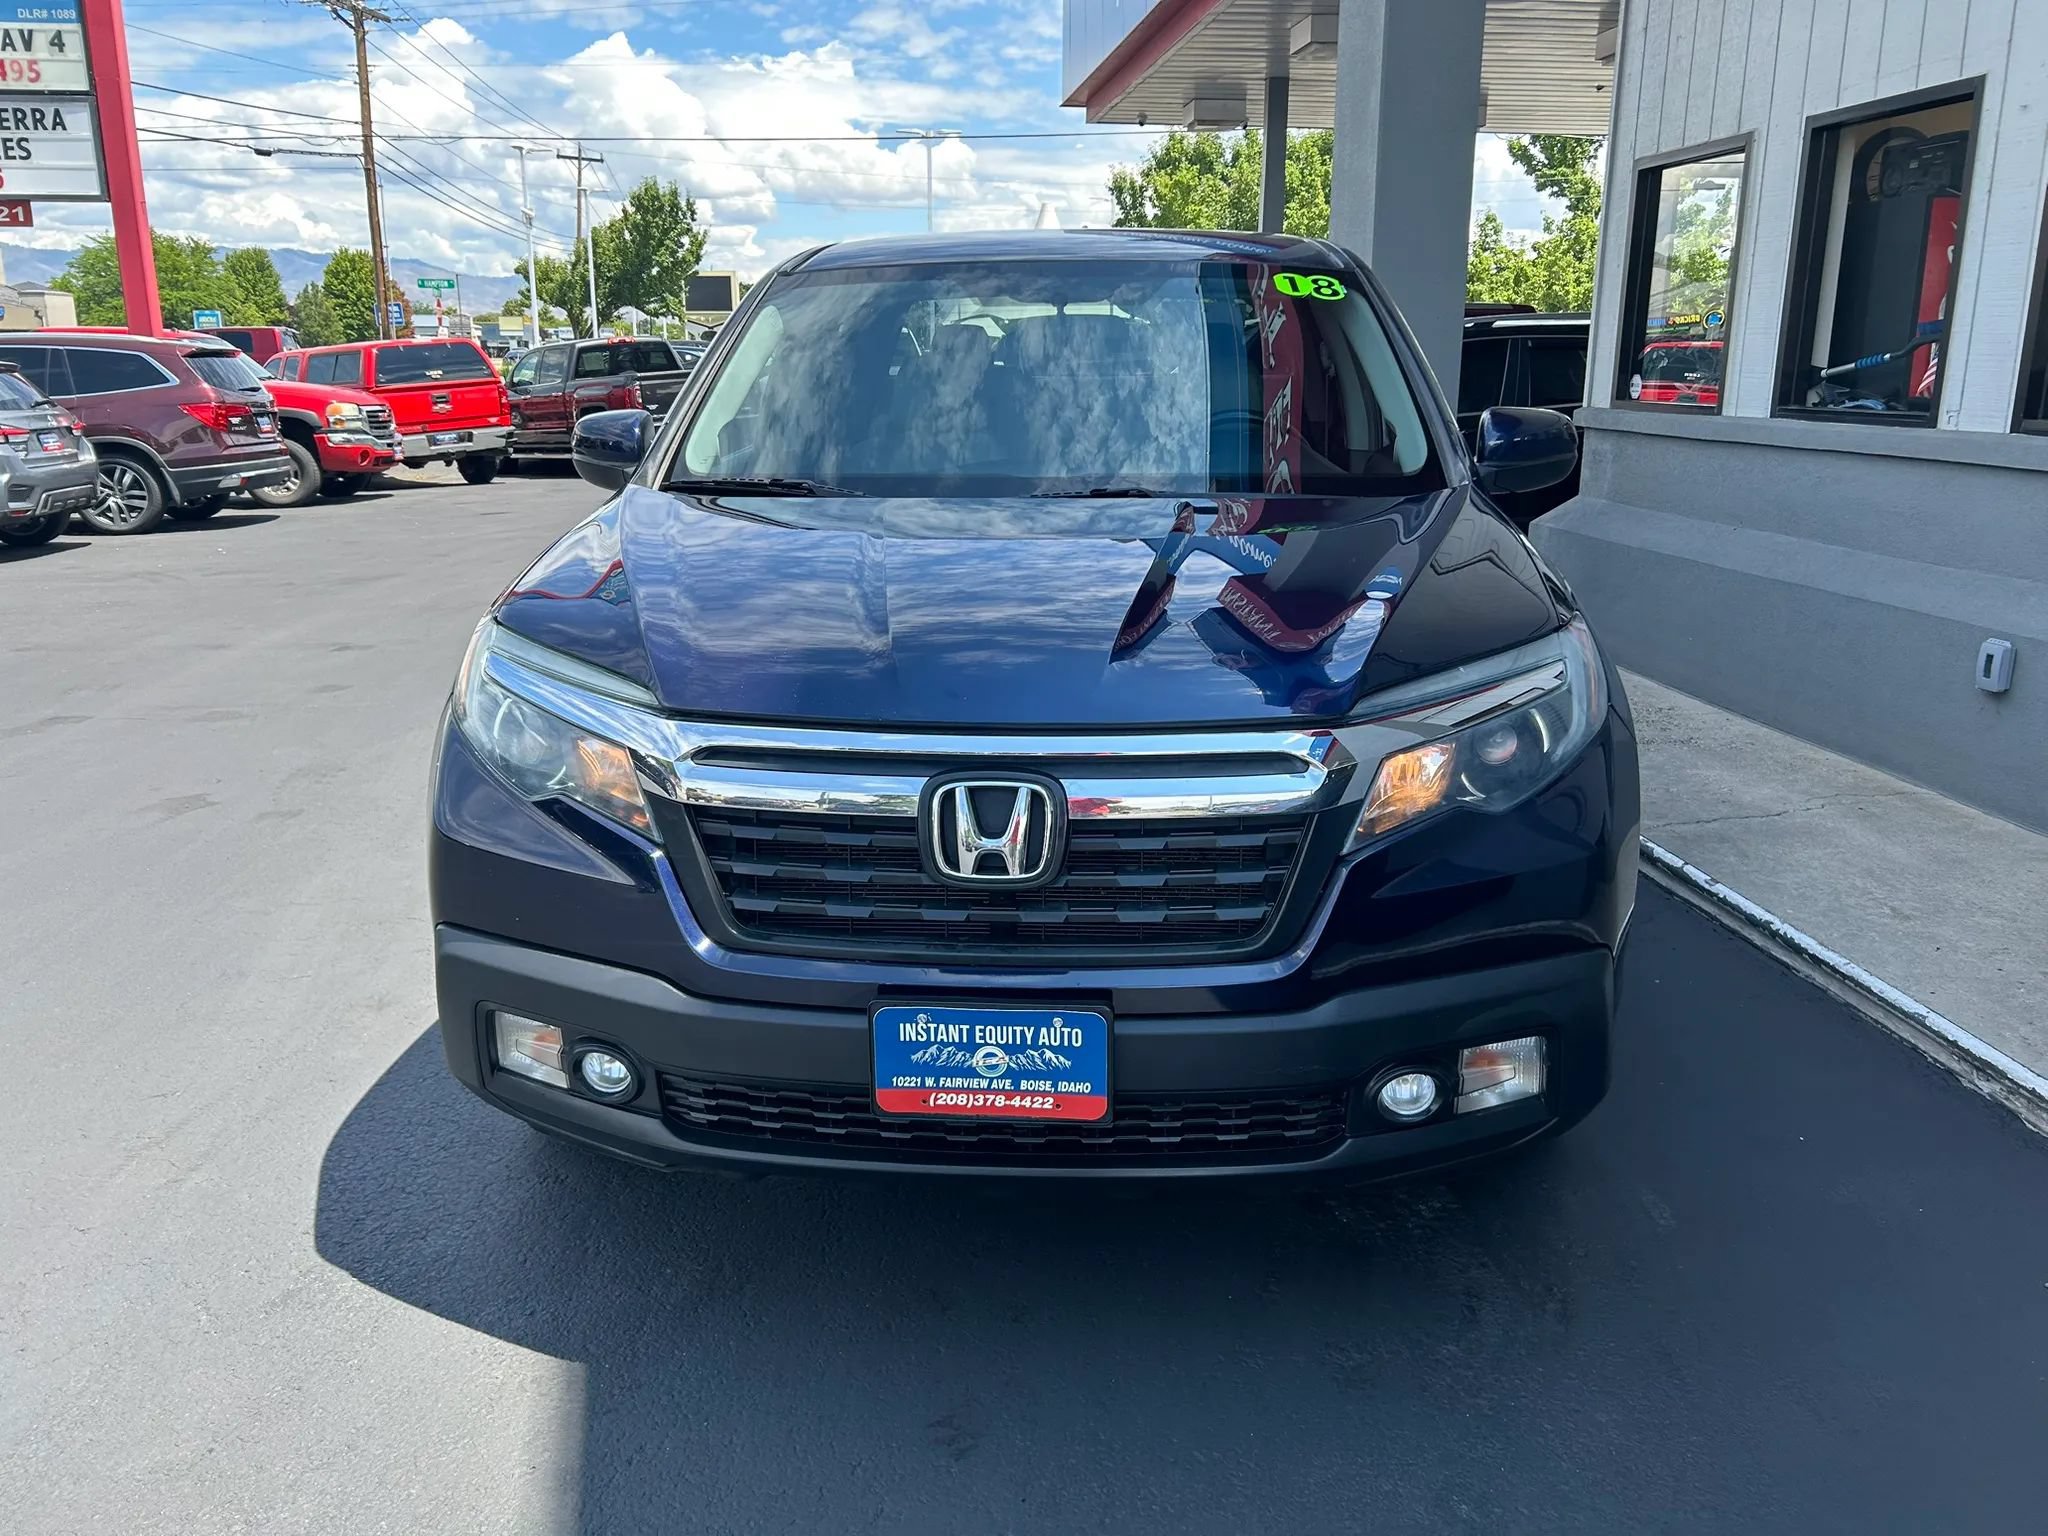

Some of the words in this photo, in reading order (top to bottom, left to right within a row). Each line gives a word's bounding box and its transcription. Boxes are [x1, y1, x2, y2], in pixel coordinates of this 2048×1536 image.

[17, 8, 48, 18] DLR#
[50, 9, 76, 19] 1089
[49, 29, 66, 53] 4
[0, 107, 67, 131] ERRA
[1282, 275, 1341, 297] 18
[899, 1023, 970, 1043] INSTANT
[975, 1025, 1034, 1045] EQUITY
[1038, 1028, 1082, 1047] AUTO
[891, 1076, 921, 1087] 10221
[925, 1077, 937, 1087] W.
[939, 1077, 989, 1089] FAIRVIEW
[991, 1079, 1014, 1090] AVE.
[1020, 1080, 1055, 1092] BOISE,
[1057, 1082, 1092, 1093] IDAHO
[929, 1093, 1054, 1109] (208)378-4422
